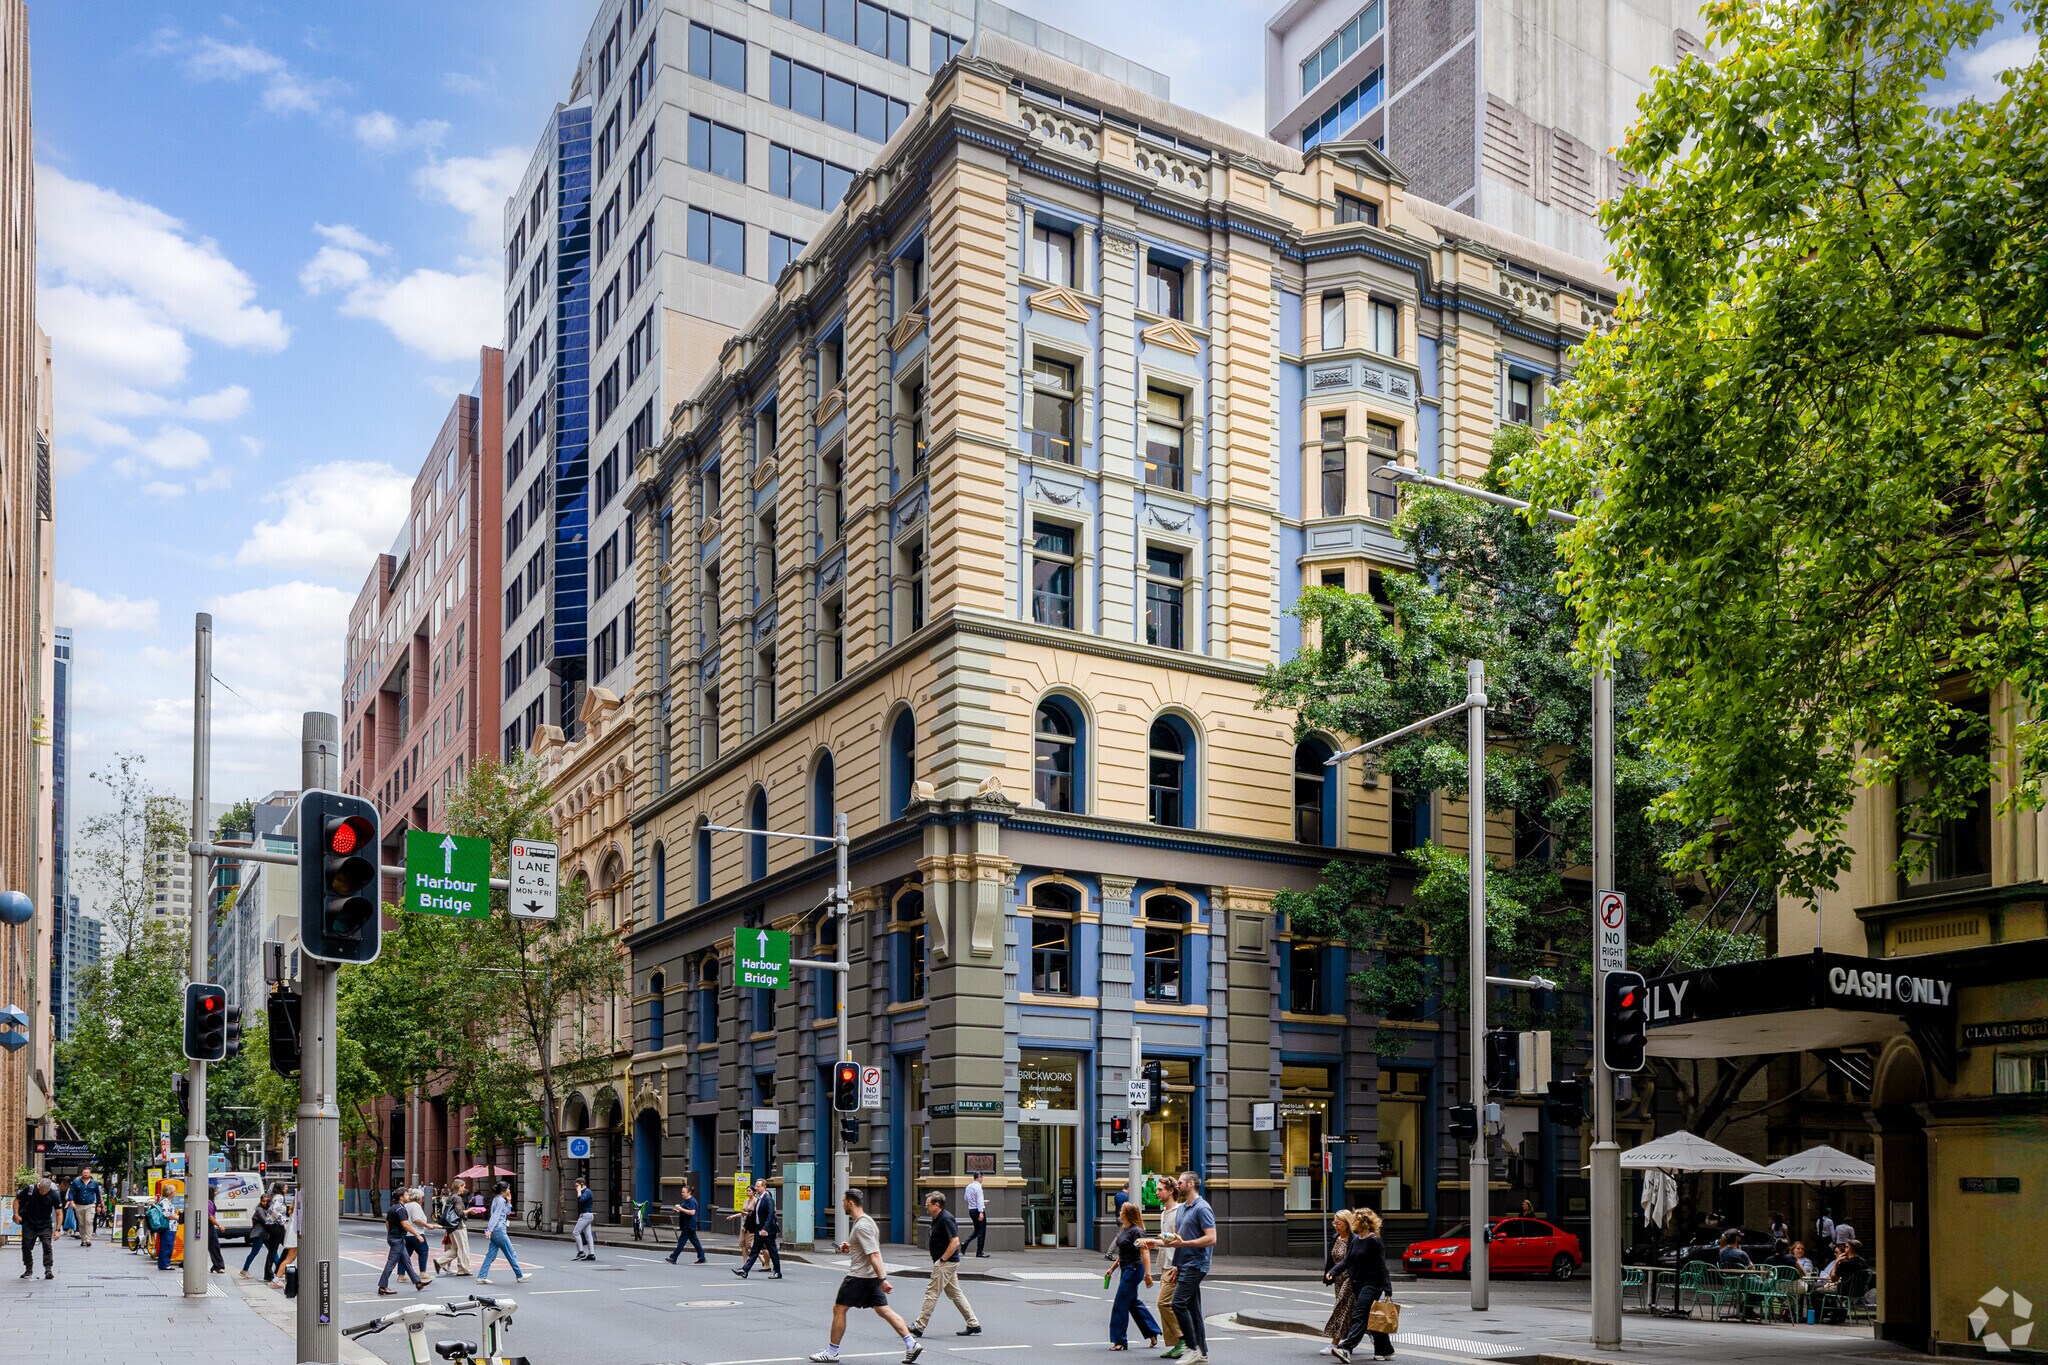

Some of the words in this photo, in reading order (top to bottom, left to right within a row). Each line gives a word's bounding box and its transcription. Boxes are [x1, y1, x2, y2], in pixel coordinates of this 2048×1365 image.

[515, 846, 523, 856] B
[518, 861, 551, 873] LANE
[416, 873, 478, 893] Harbour
[419, 893, 472, 914] Bridge
[1605, 932, 1620, 945] NO
[1602, 947, 1623, 957] RIGHT
[742, 958, 782, 971] Harbour
[1602, 958, 1623, 968] TURN
[744, 972, 778, 986] Bridge
[1828, 967, 1892, 1000] CASH
[1895, 975, 1952, 1006] ONLY
[1018, 1071, 1073, 1082] BRICKWORKS
[1130, 1082, 1146, 1090] ONE
[1130, 1091, 1147, 1099] WAY
[1700, 1155, 1743, 1164] MINUTY
[228, 1182, 259, 1199] goget
